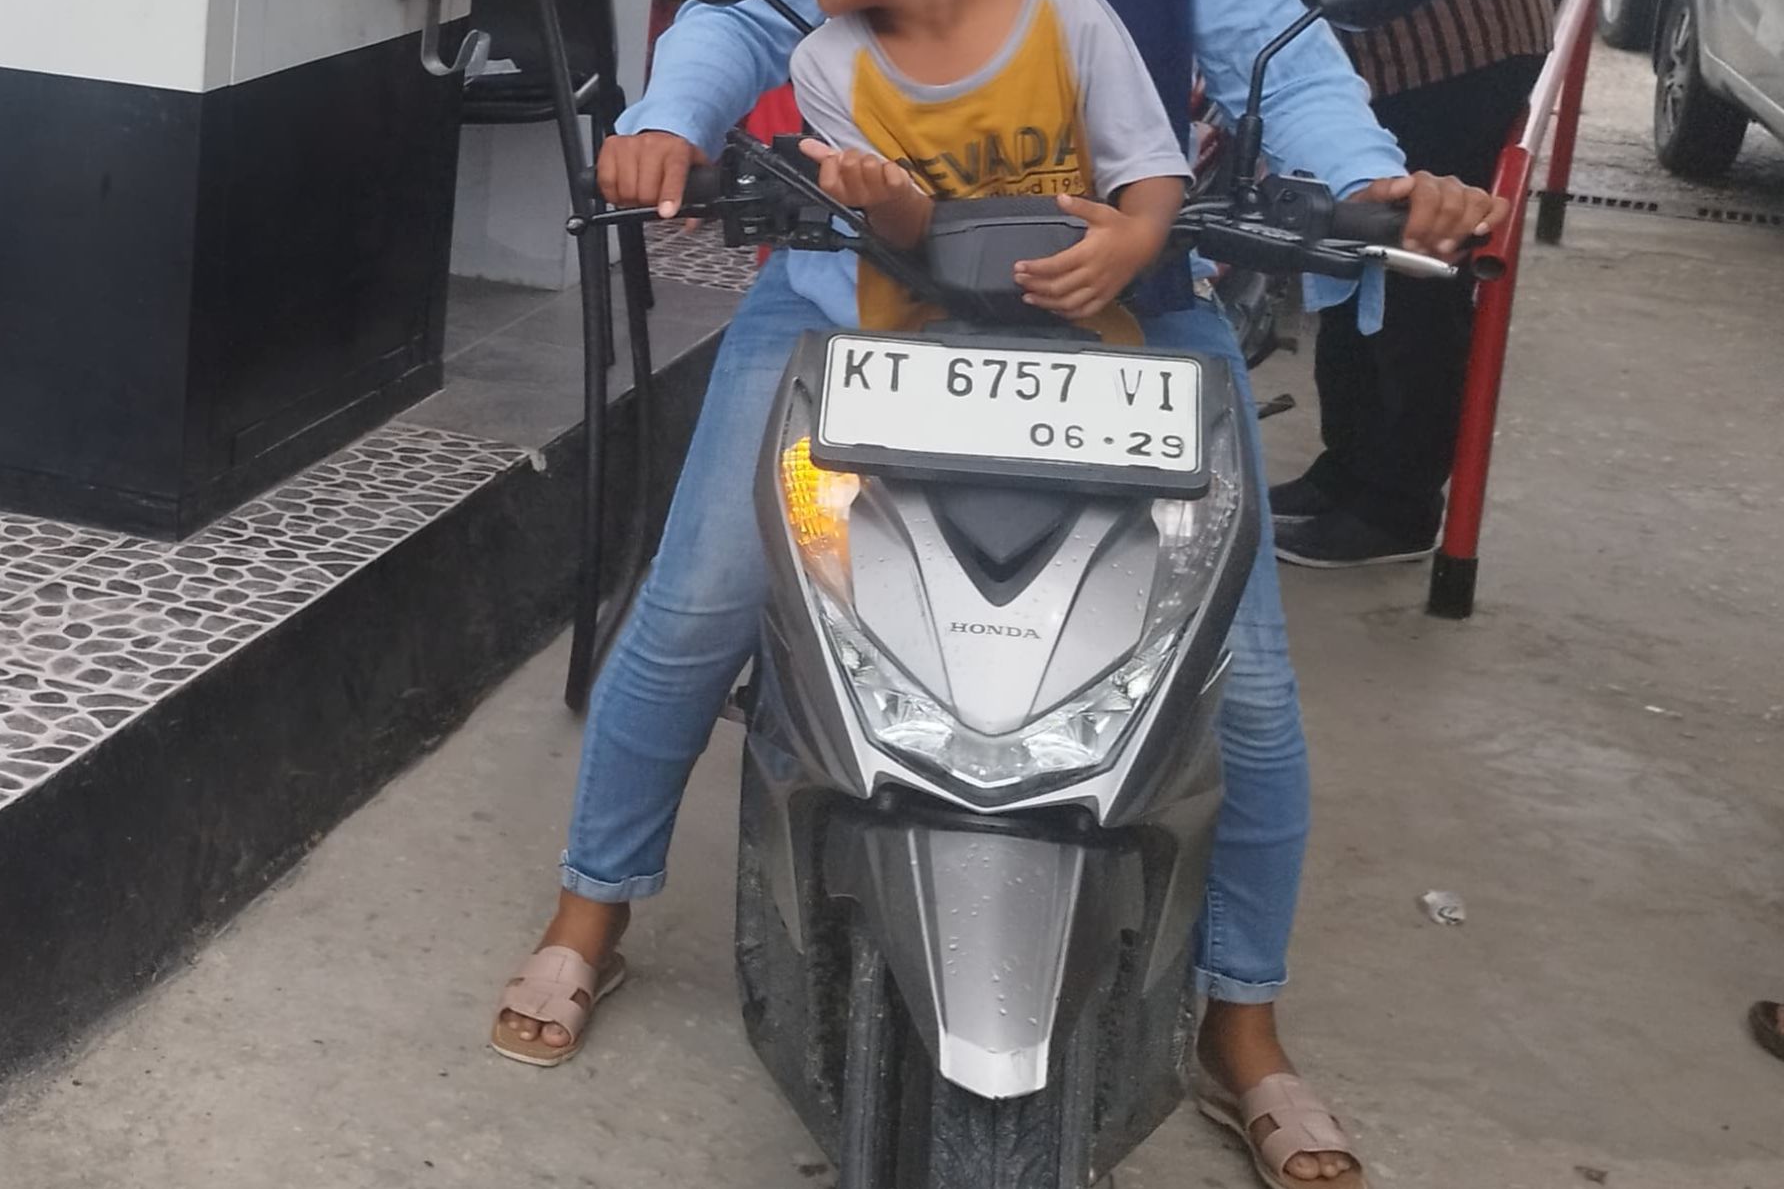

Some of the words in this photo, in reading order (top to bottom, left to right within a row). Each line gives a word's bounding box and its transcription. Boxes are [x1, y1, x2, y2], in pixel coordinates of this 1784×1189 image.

[843, 349, 909, 391] KT
[946, 357, 1077, 402] 6757
[1119, 368, 1173, 411] VI
[950, 622, 1041, 639] HONDA
